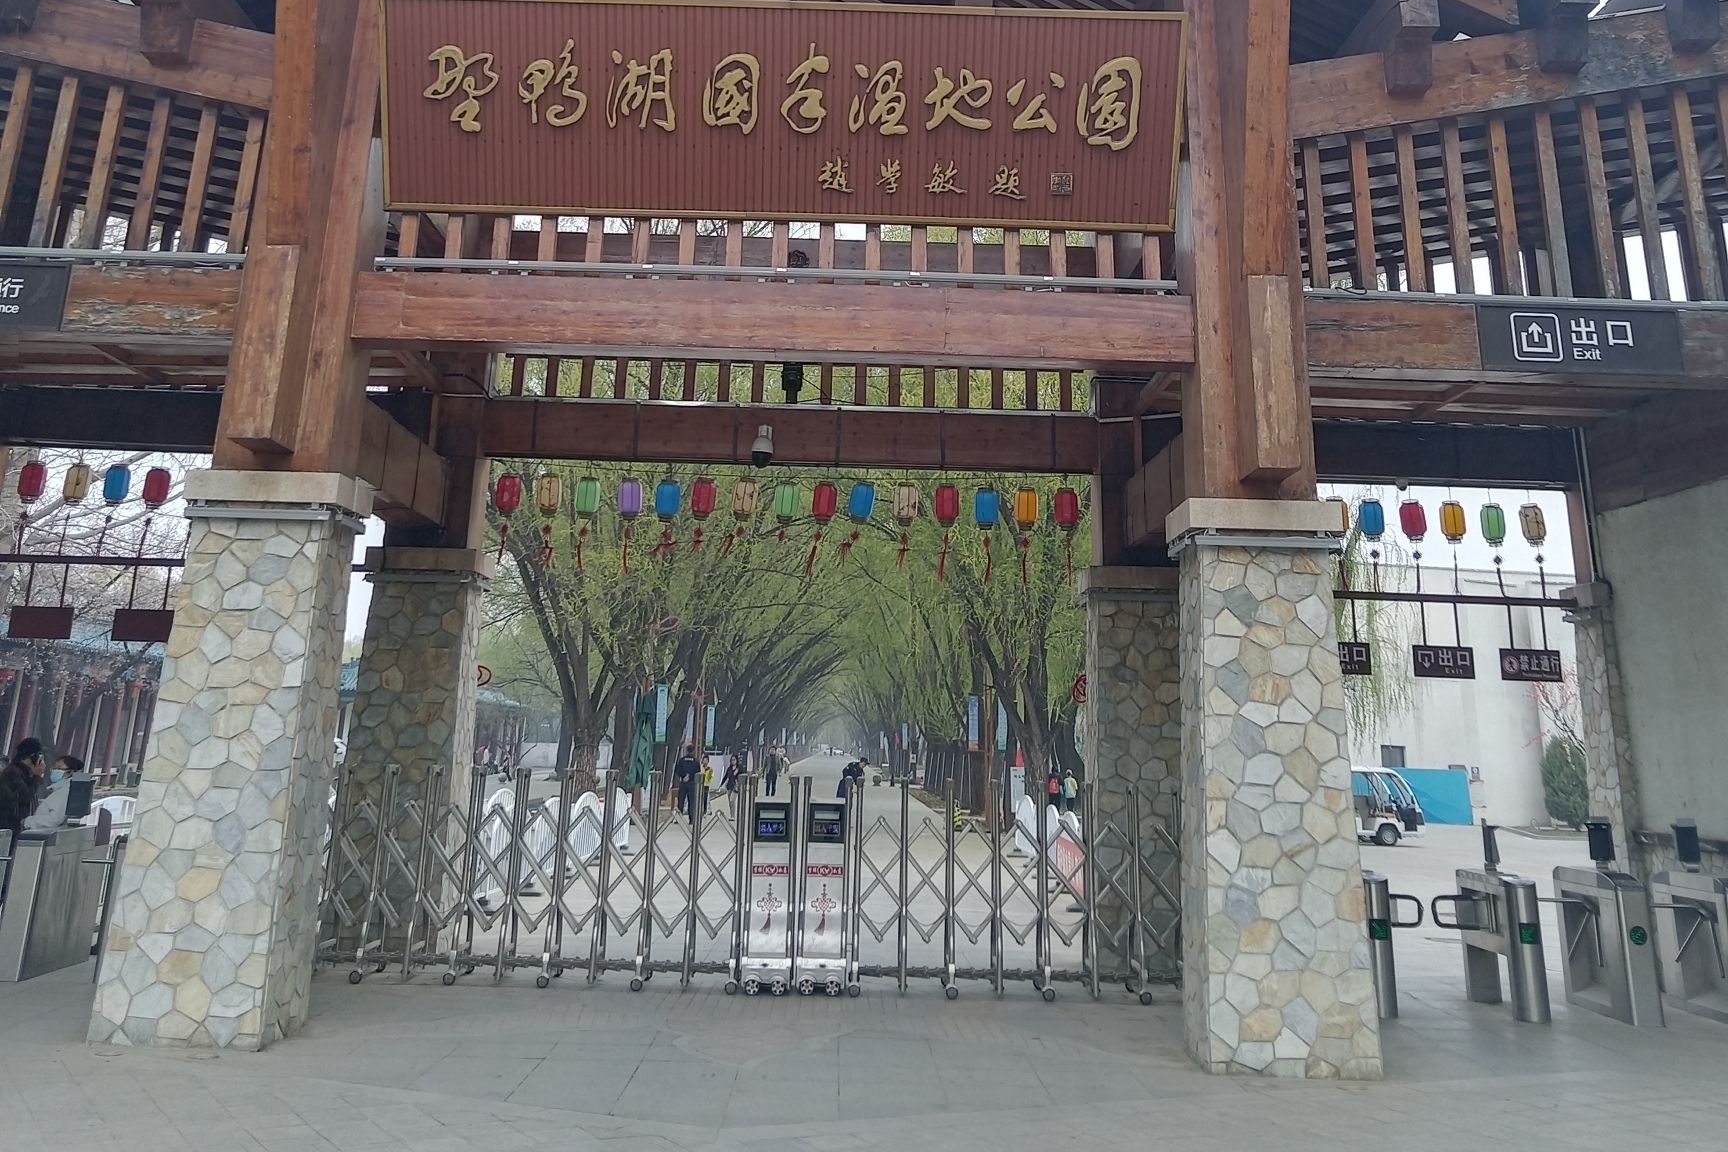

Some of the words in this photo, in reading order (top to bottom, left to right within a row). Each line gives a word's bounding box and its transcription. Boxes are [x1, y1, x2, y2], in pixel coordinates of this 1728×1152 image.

[1570, 317, 1634, 347] 出口
[1573, 348, 1602, 361] Exit
[1438, 649, 1470, 666] 出口
[1519, 655, 1559, 672] 禁止通行
[1444, 667, 1463, 675] Exit
